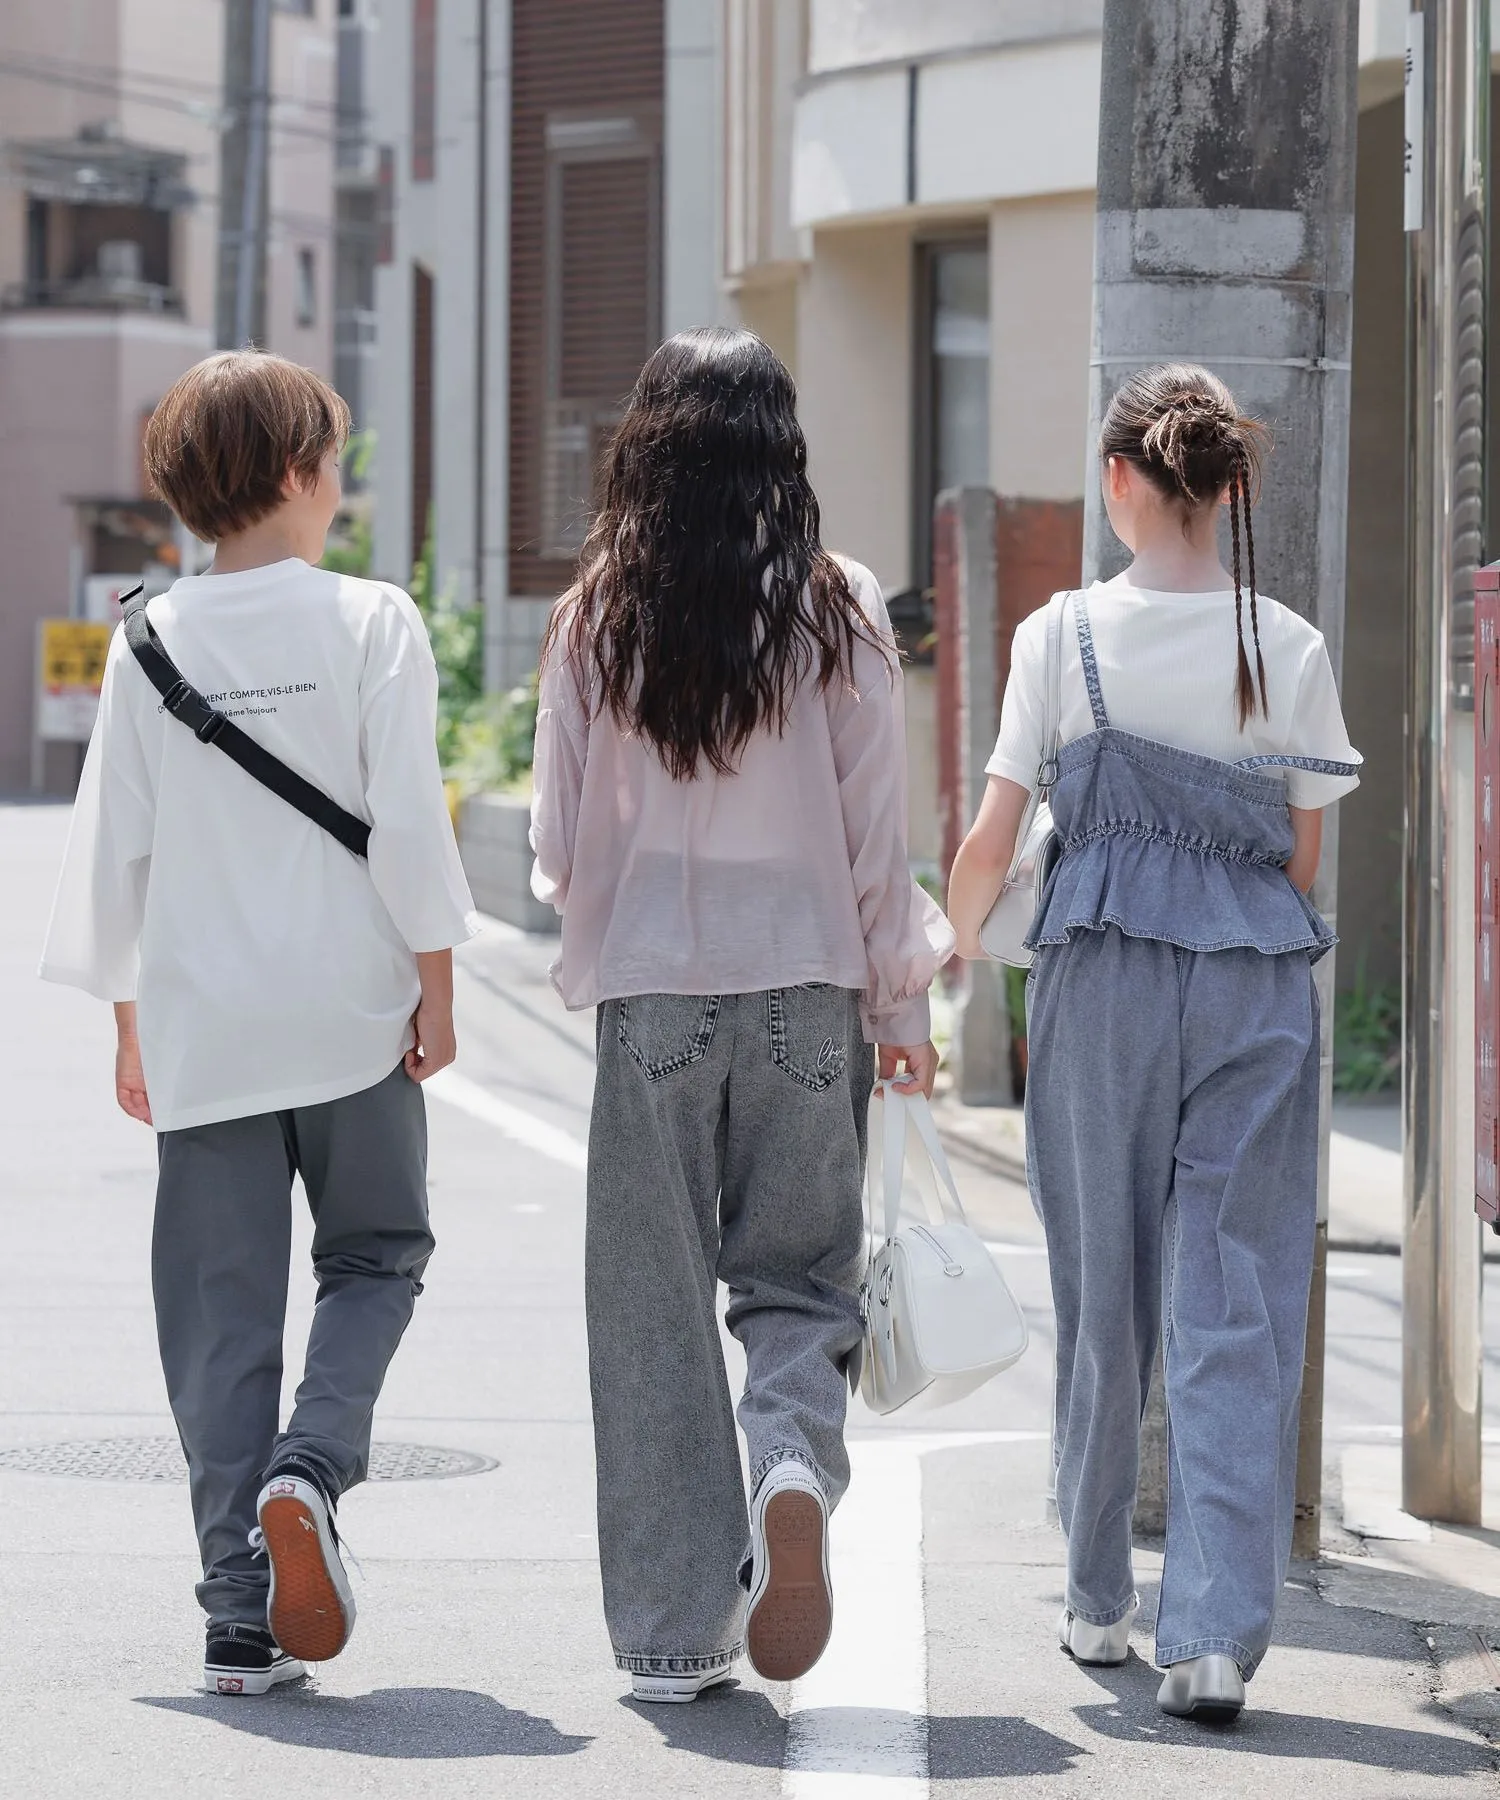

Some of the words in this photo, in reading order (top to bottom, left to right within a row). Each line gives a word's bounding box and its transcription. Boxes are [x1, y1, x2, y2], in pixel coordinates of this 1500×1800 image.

[295, 683, 316, 692] BIEN
[245, 706, 277, 715] Toujours
[776, 1477, 810, 1486] CONVERSE
[637, 1687, 670, 1695] CONVERSE
